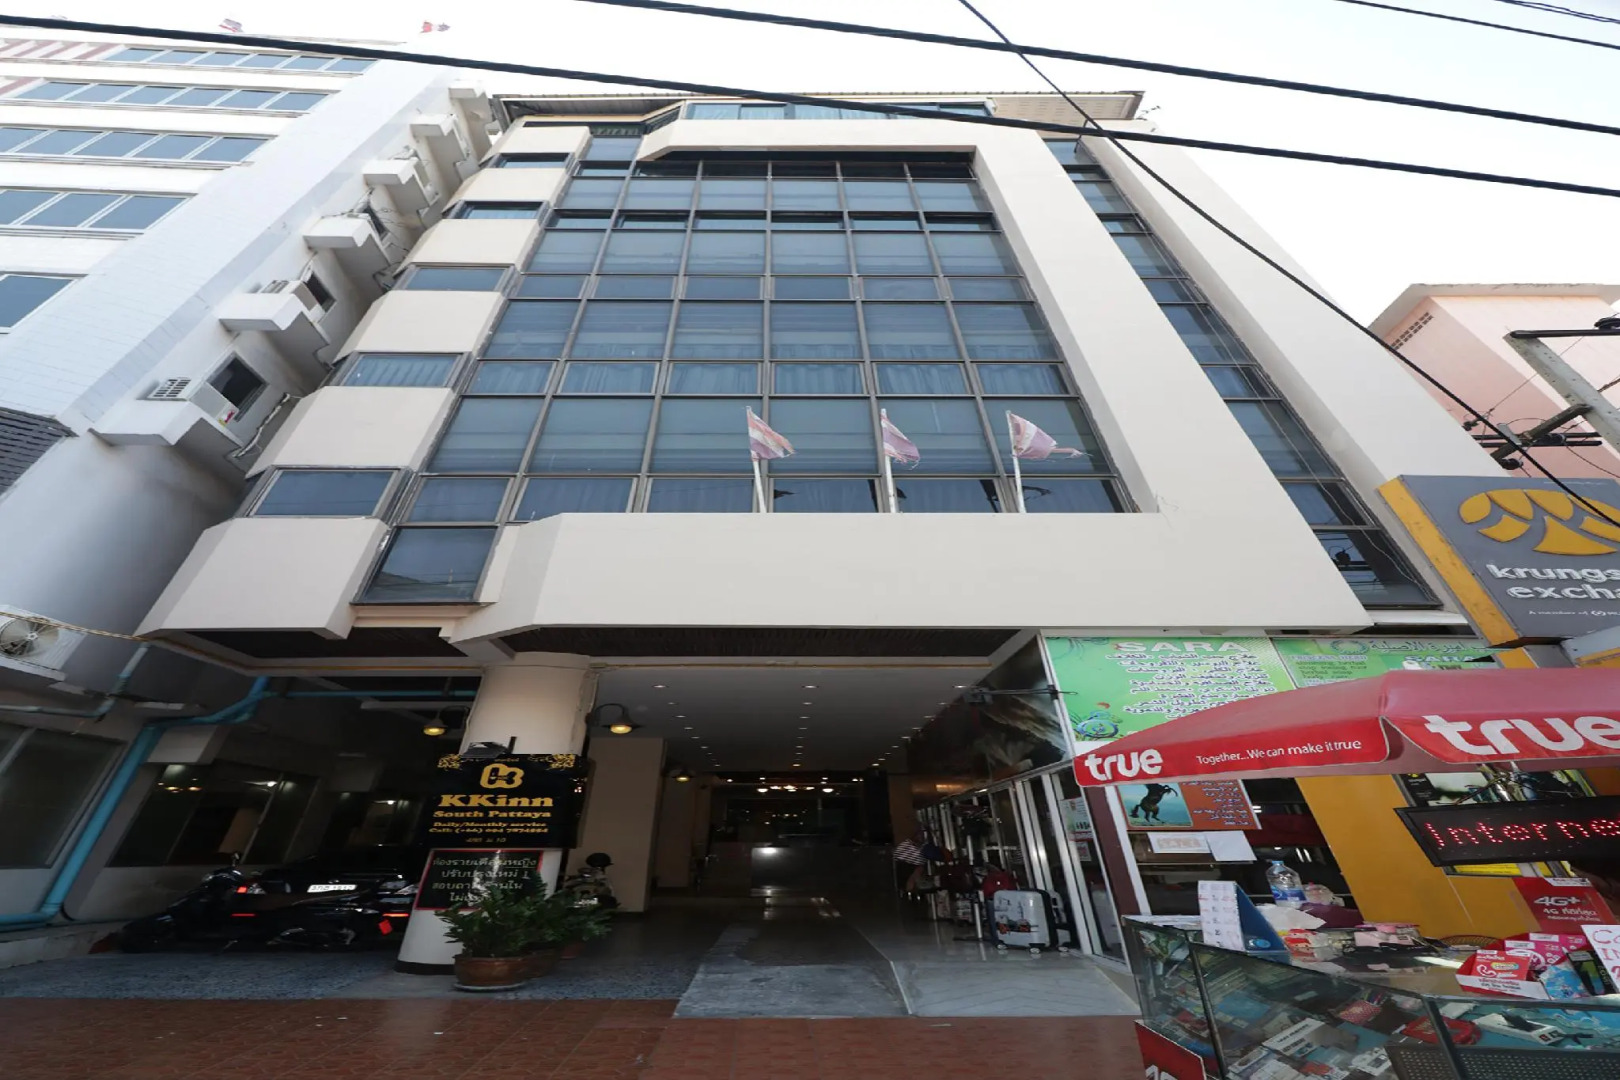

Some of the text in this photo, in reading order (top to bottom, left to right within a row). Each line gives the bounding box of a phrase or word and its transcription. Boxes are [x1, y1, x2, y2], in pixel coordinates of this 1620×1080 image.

[1118, 641, 1250, 652] SARA
[1421, 714, 1620, 755] true
[1267, 748, 1285, 757] can
[1287, 743, 1324, 755] make
[1324, 742, 1333, 752] it
[1333, 740, 1363, 751] true
[1085, 748, 1163, 781] true
[432, 810, 552, 819] South Pattaya
[1533, 896, 1581, 907] 4G+
